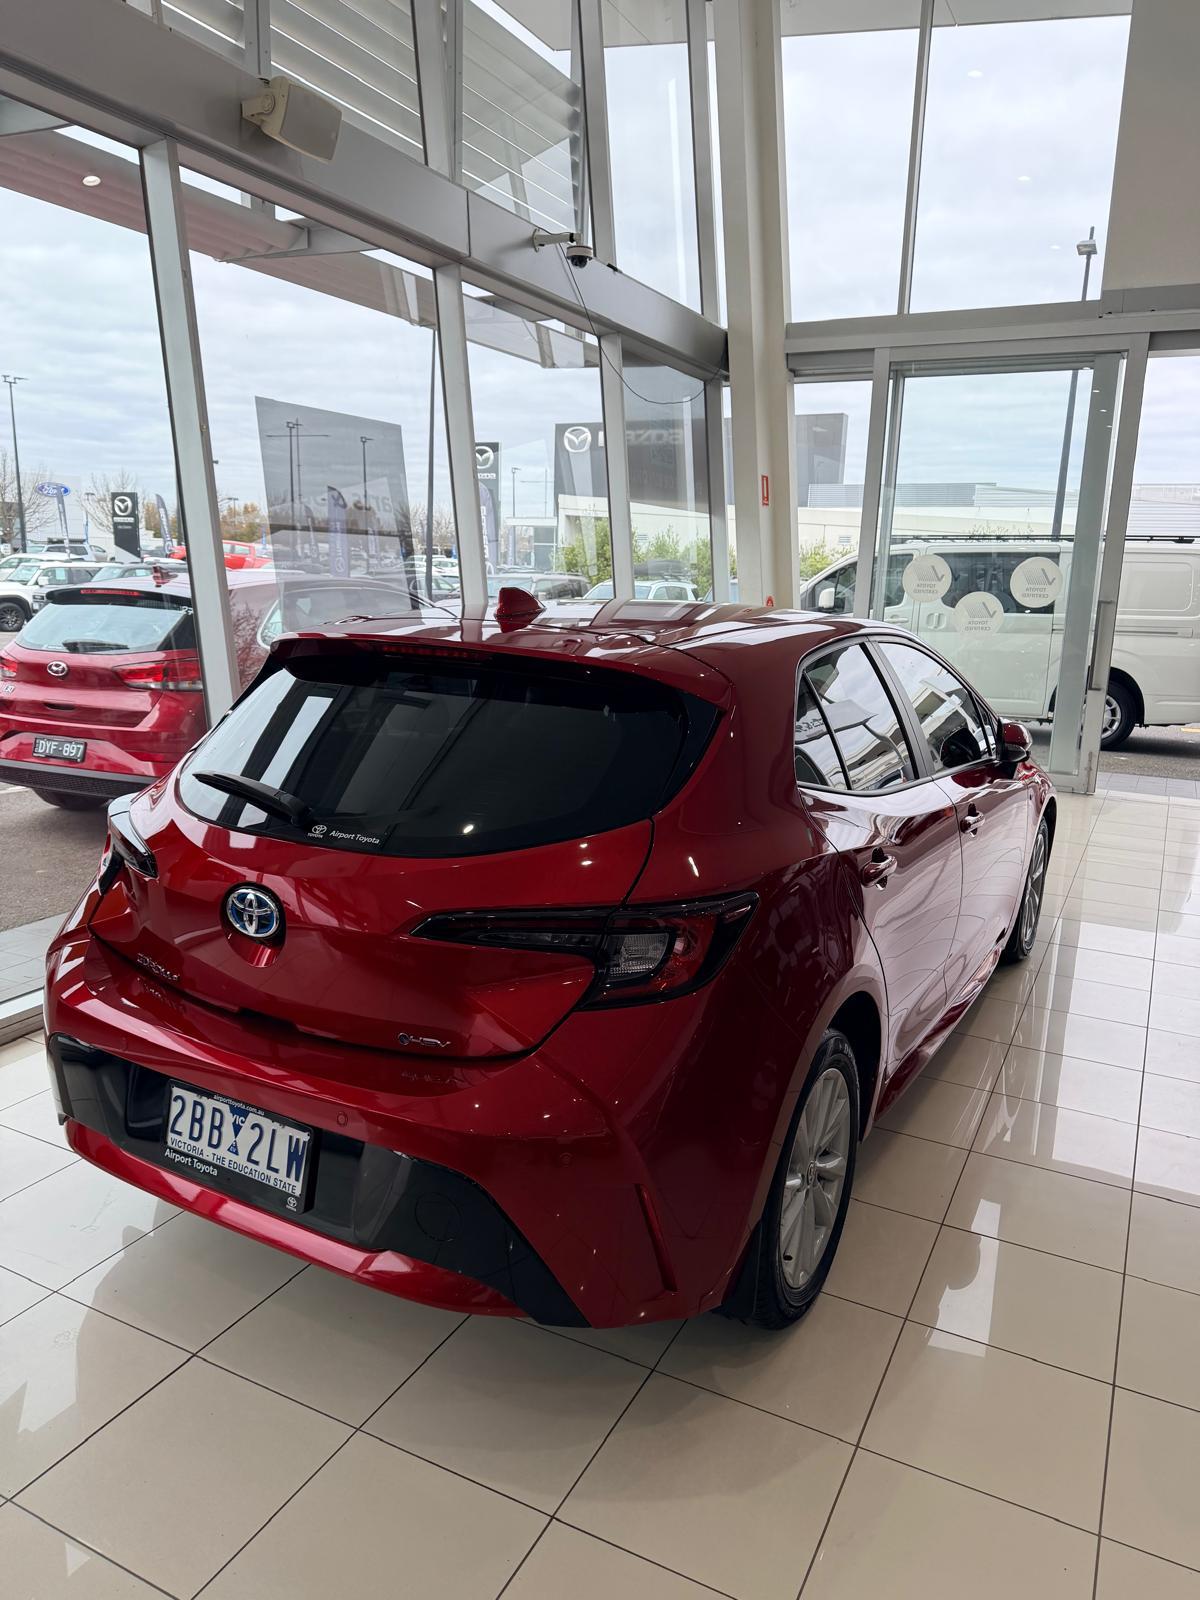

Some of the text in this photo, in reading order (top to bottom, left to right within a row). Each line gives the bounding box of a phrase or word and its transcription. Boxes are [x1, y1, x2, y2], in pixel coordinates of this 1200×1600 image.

[329, 830, 381, 845] Airport Toyota
[213, 1094, 265, 1116] airporttoyota.com.au
[232, 1113, 246, 1126] VIC
[169, 1094, 309, 1182] 2BB 2LW
[165, 1148, 218, 1177] Airport Toyota
[170, 1136, 205, 1158] VICTORIA
[211, 1152, 227, 1166] THE
[228, 1157, 272, 1184] EDUCATION
[273, 1176, 297, 1195] STATE
